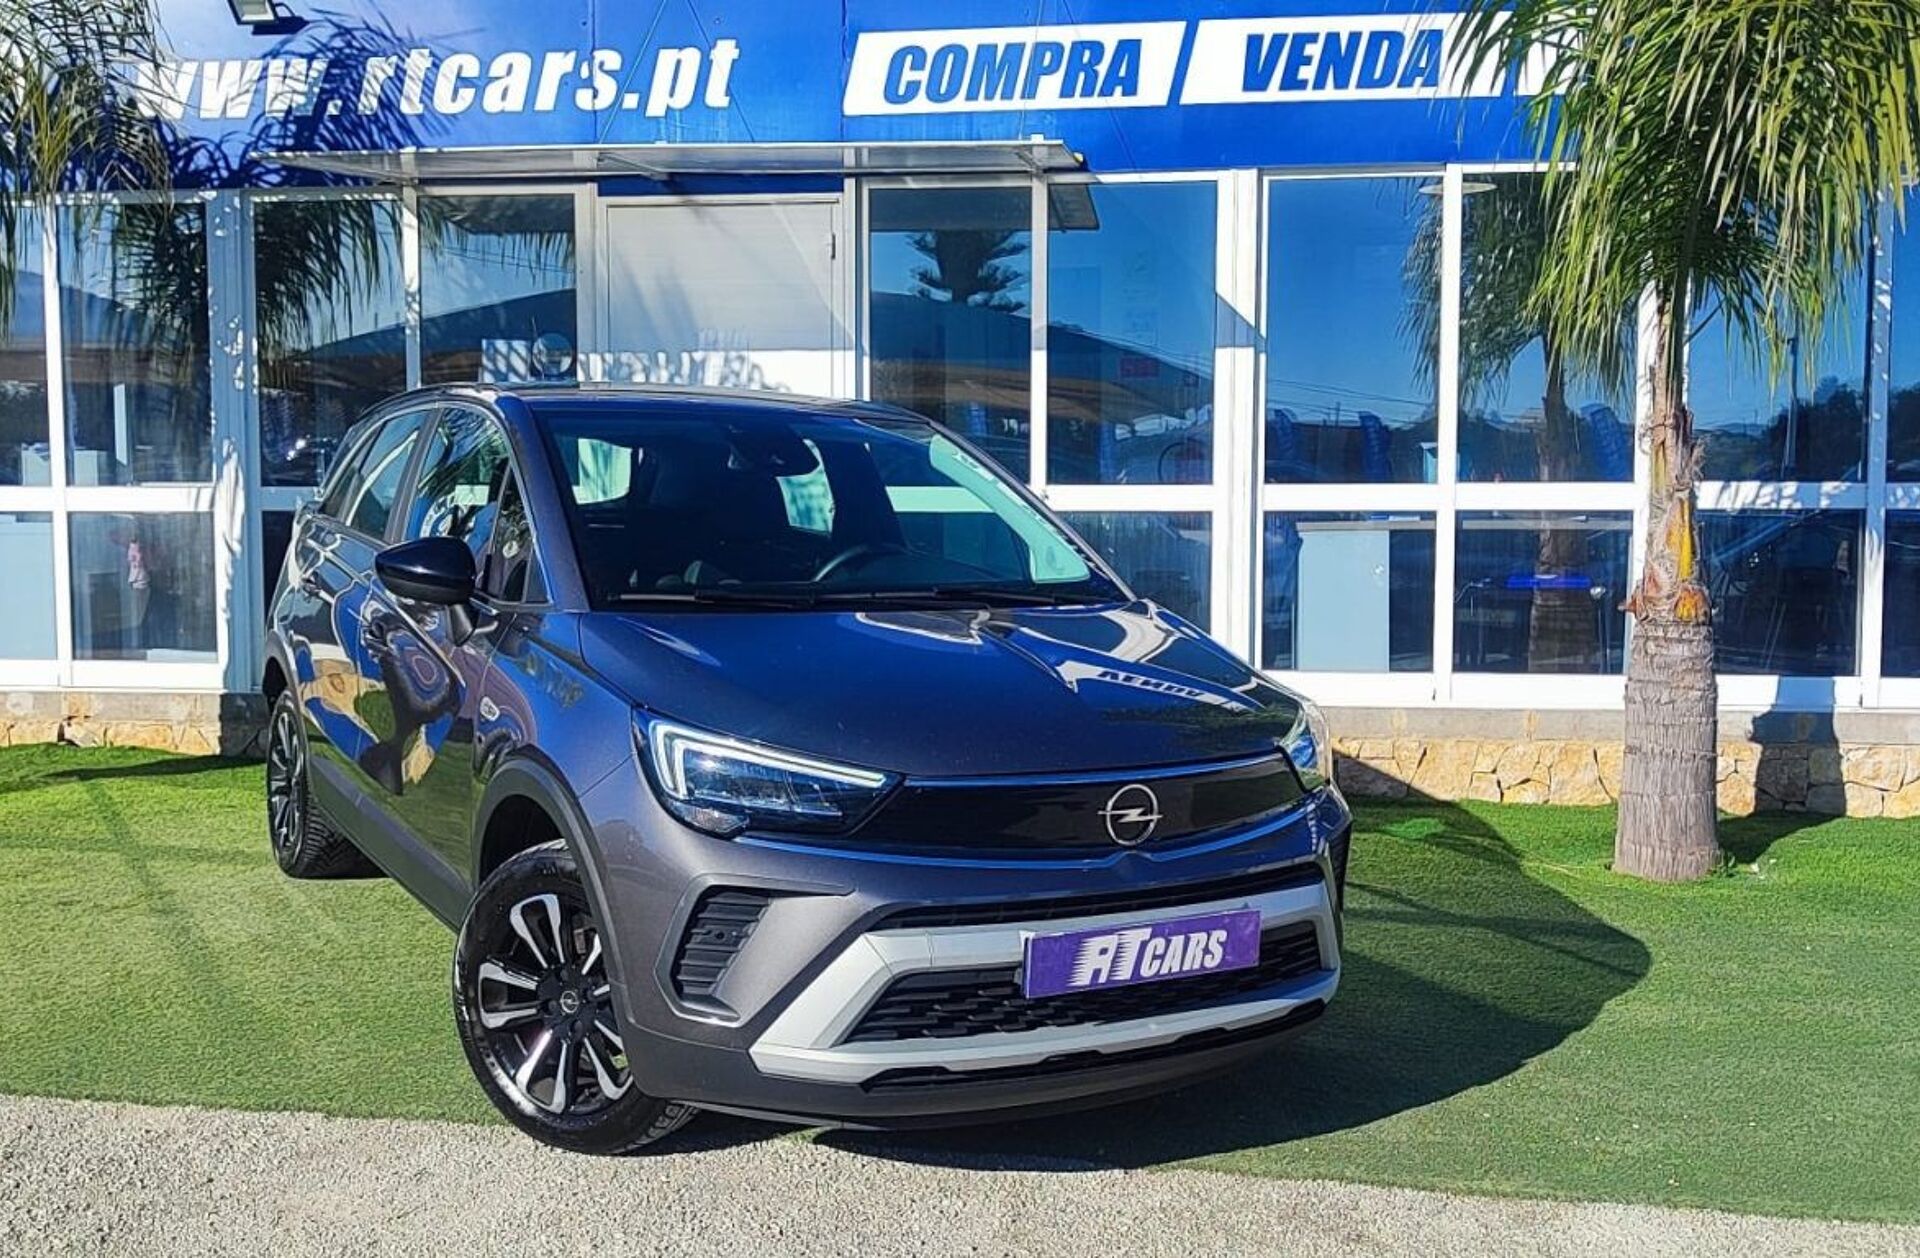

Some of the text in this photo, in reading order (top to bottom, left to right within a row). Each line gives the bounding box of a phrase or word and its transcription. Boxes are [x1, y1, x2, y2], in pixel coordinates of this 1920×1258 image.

[136, 38, 739, 119] www.rtcars.pt
[883, 39, 1142, 104] COMPRA
[1241, 29, 1444, 92] VENDA
